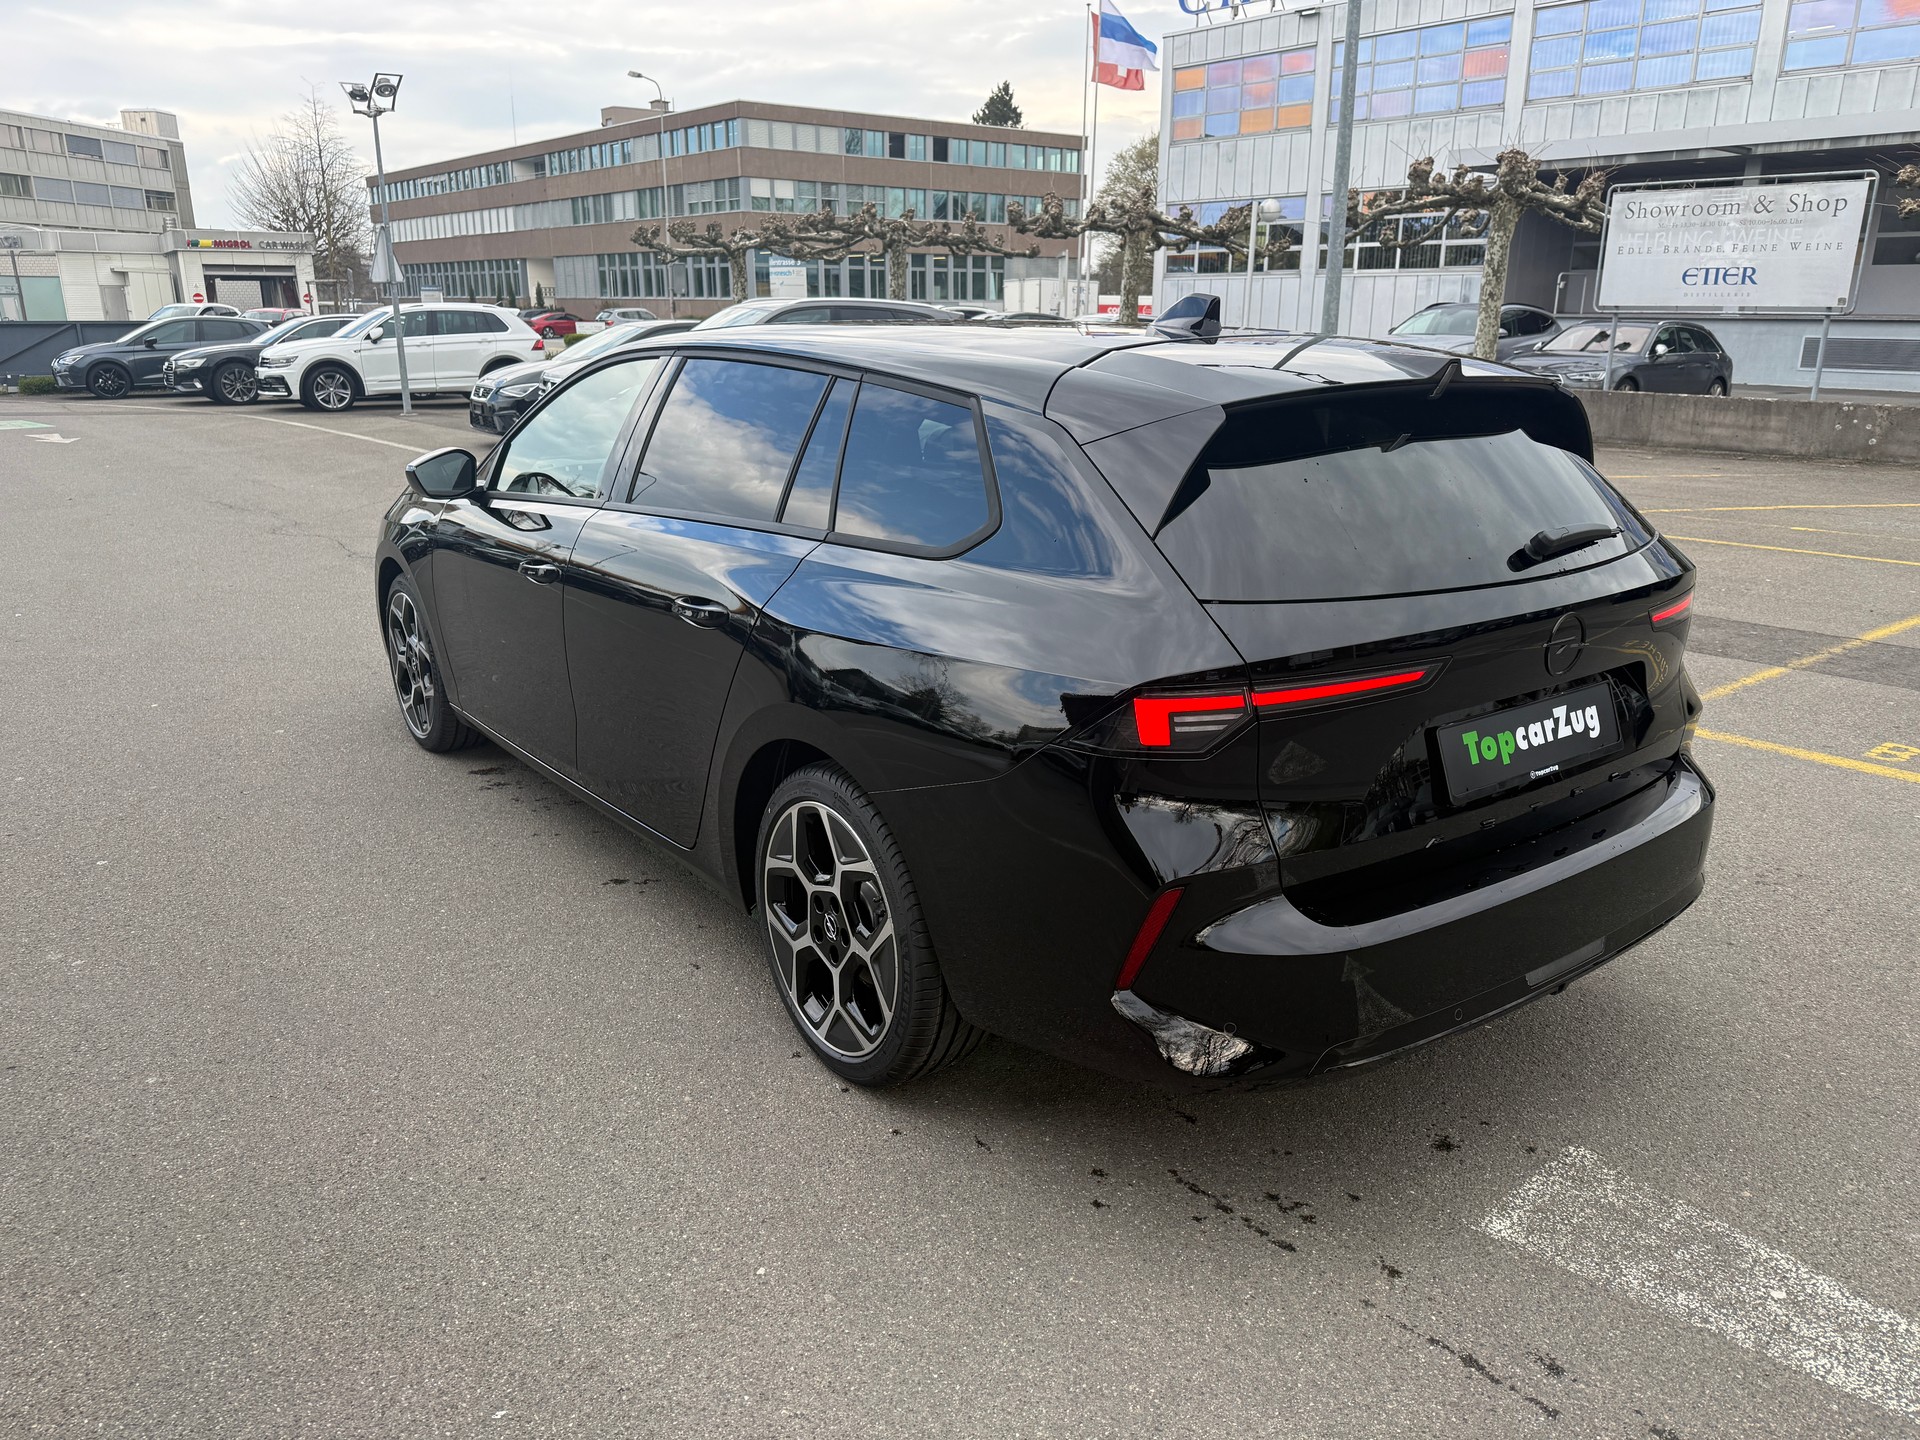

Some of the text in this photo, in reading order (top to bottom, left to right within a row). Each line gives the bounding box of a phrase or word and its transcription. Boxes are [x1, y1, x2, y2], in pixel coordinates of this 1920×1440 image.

[1625, 193, 1848, 219] Showroom & Shop
[213, 239, 253, 249] MIGROL
[258, 240, 309, 250] CAR WASH
[1617, 246, 1653, 255] EDLE
[1731, 243, 1778, 253] FEINE
[1790, 241, 1844, 251] WEINE
[1681, 266, 1758, 286] ETTER
[1461, 704, 1601, 766] TopcarZug
